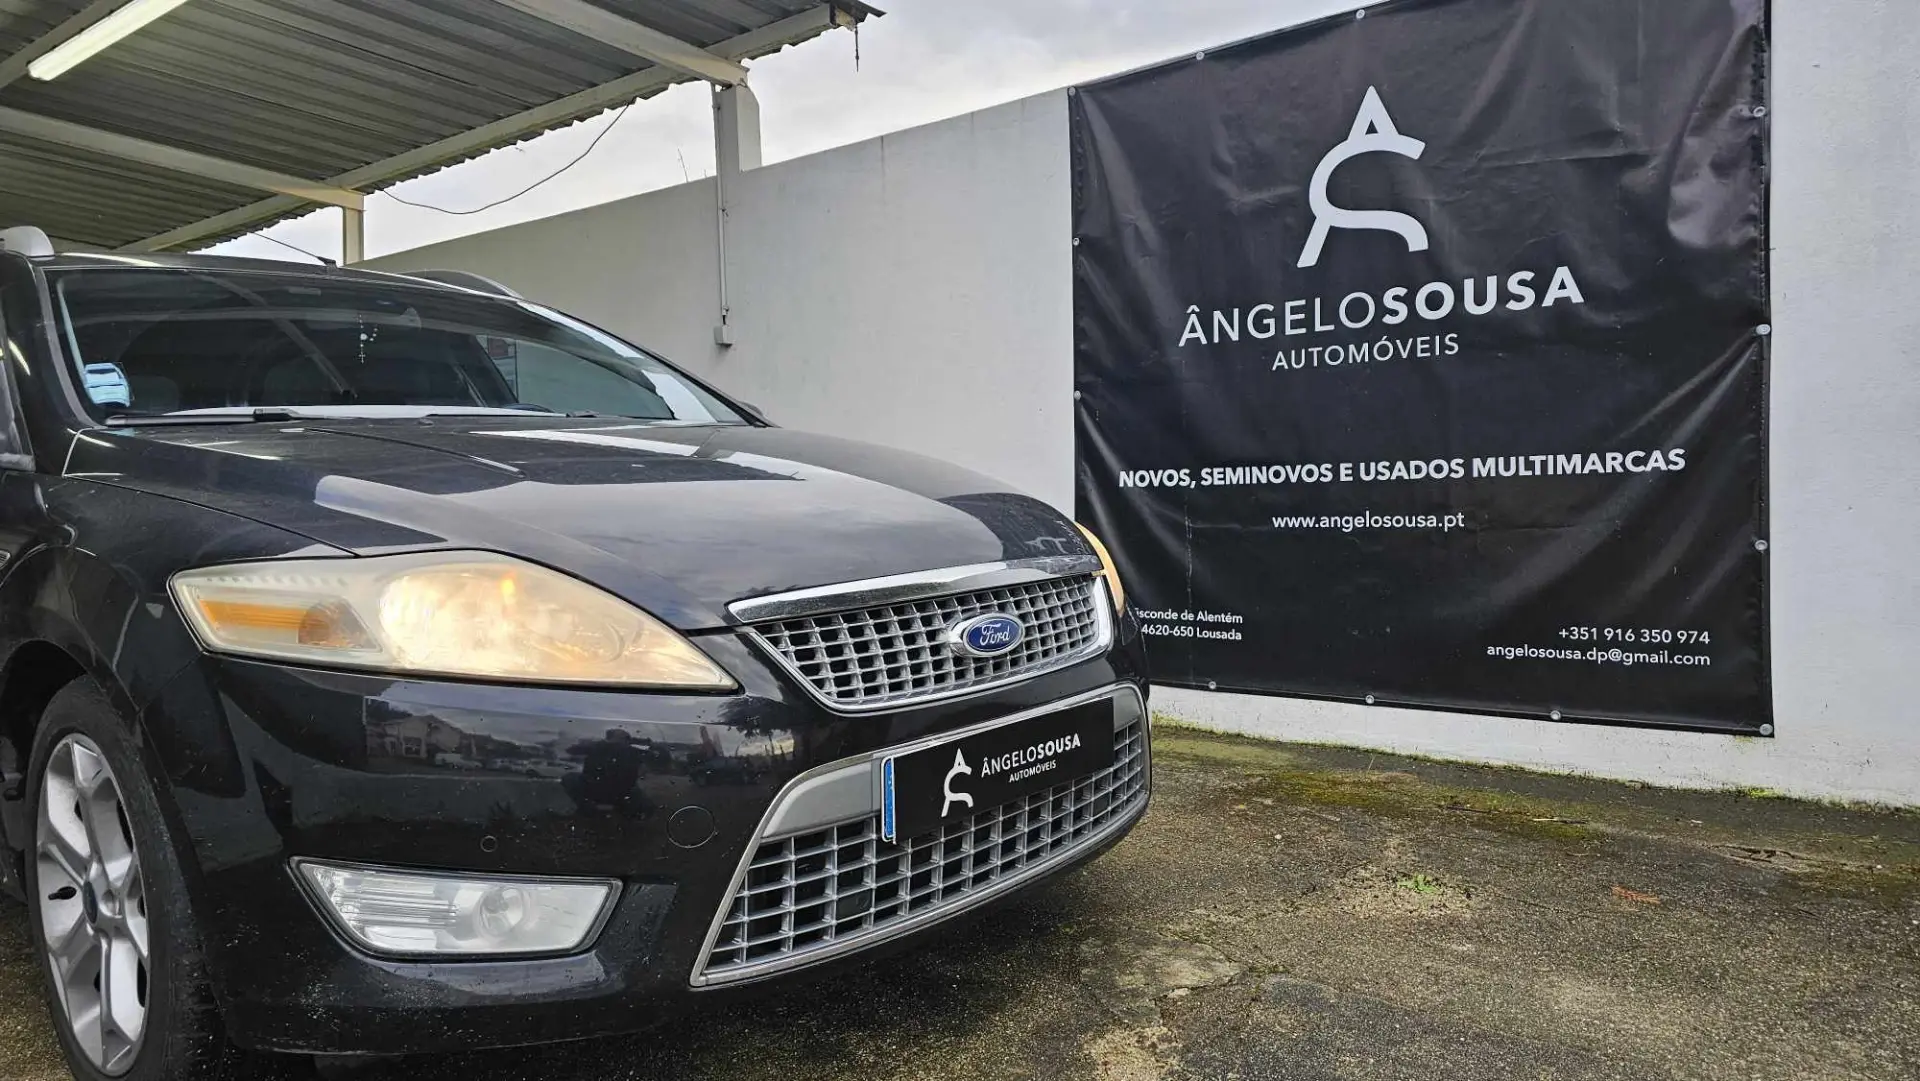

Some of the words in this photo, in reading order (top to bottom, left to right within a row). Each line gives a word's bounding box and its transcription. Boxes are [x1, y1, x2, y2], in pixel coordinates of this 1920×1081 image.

[1178, 265, 1585, 347] ÂNGELOSOUSA
[1271, 333, 1460, 371] AUTOMÓVEIS
[1118, 468, 1197, 489] NOVOS,
[1200, 463, 1333, 486] SEMINOVOS
[1339, 461, 1353, 482] E
[1359, 458, 1465, 481] USADOS
[1472, 448, 1686, 477] MULTIMARCAS
[1272, 511, 1465, 532] www.angelosousa.pt
[1181, 609, 1194, 620] de
[1197, 610, 1242, 623] Alentém
[980, 623, 1010, 646] Ford
[1141, 624, 1193, 637] 4620-650
[1197, 627, 1242, 640] Lousada
[1558, 626, 1598, 640] +351
[1604, 627, 1635, 642] 916
[1640, 629, 1672, 643] 350
[1676, 630, 1711, 644] 974
[1486, 644, 1711, 666] angelosousa.dp@gmail.com
[981, 733, 1081, 778] ÂNGELOSOUSA
[1008, 759, 1057, 783] AUTOMÓVEIS
